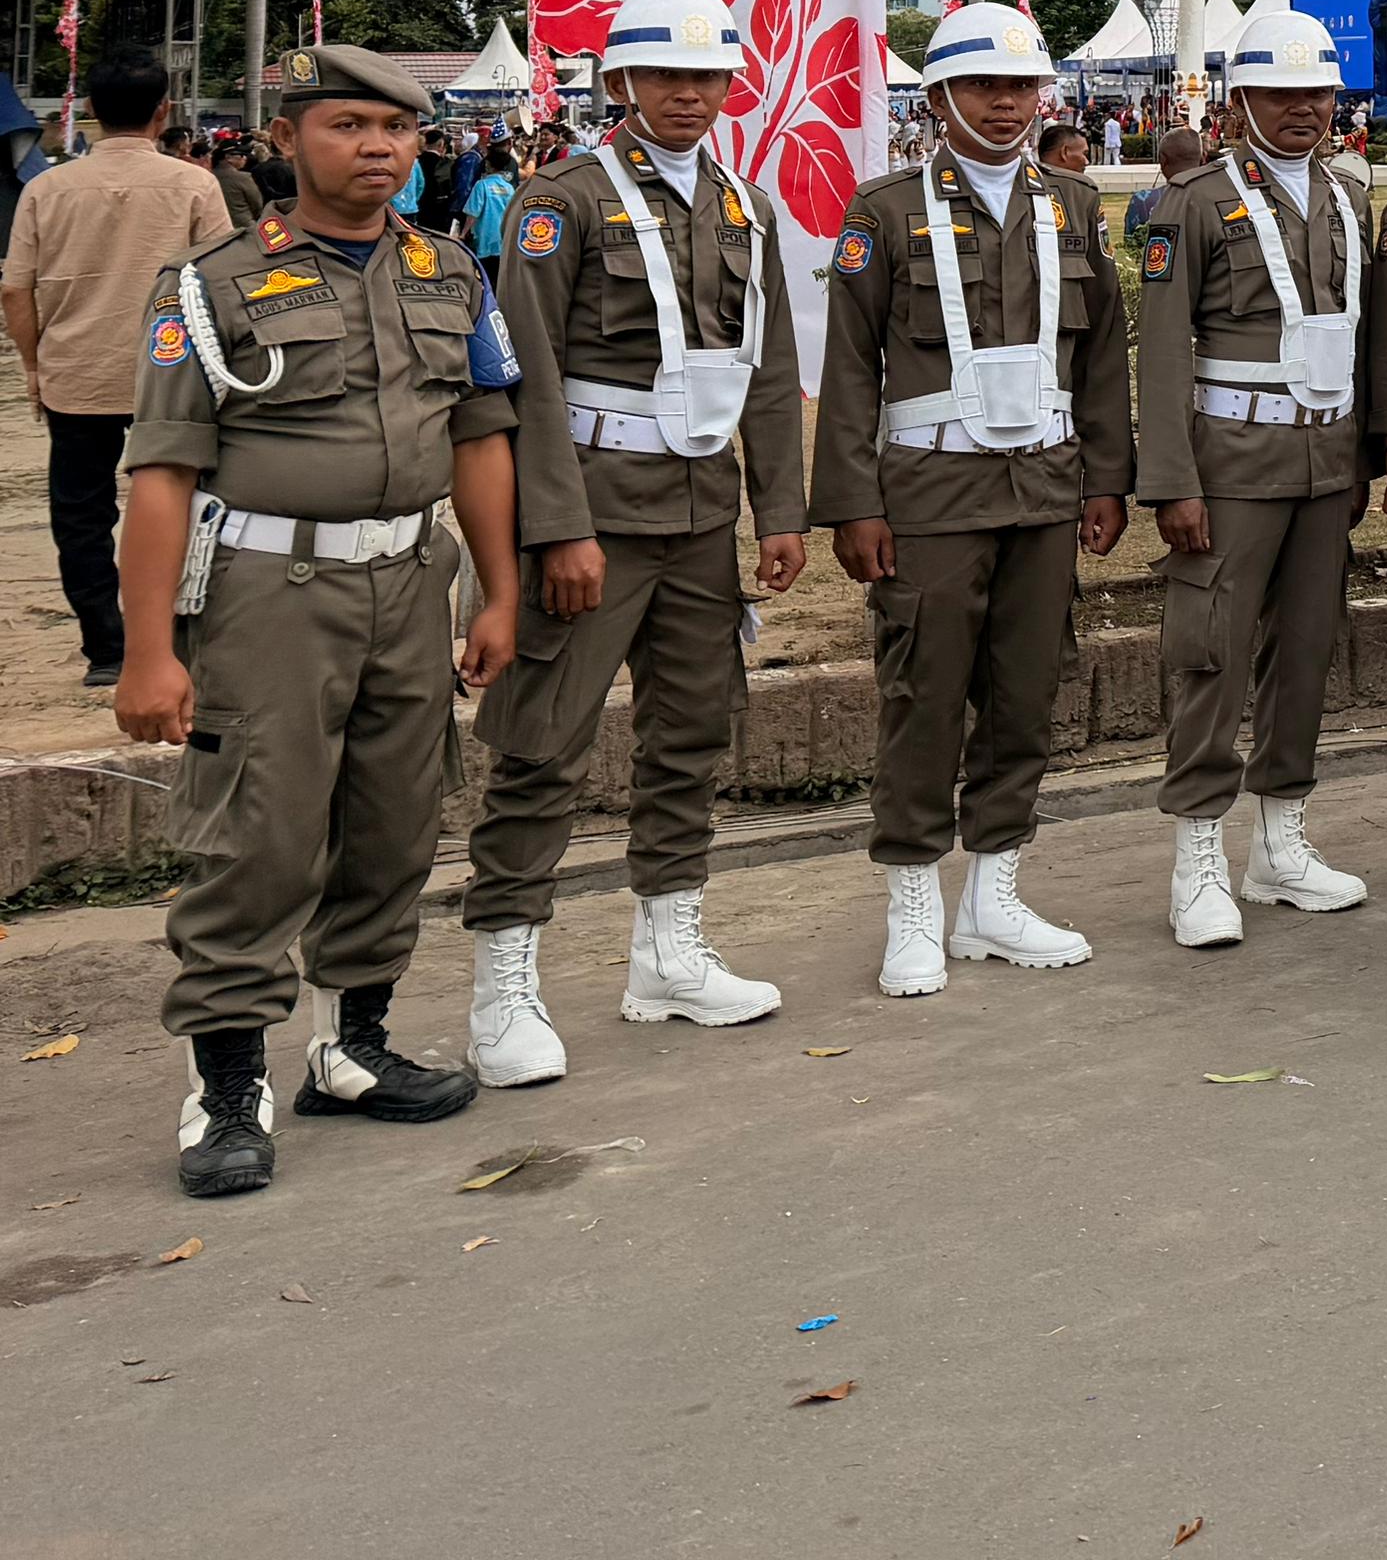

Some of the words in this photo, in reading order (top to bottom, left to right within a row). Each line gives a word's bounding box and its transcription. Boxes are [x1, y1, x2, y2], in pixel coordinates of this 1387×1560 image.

[1064, 238, 1081, 249] PP
[400, 283, 432, 294] POL
[437, 284, 458, 296] PP
[253, 301, 282, 317] AGUS
[286, 292, 330, 308] MARWAN
